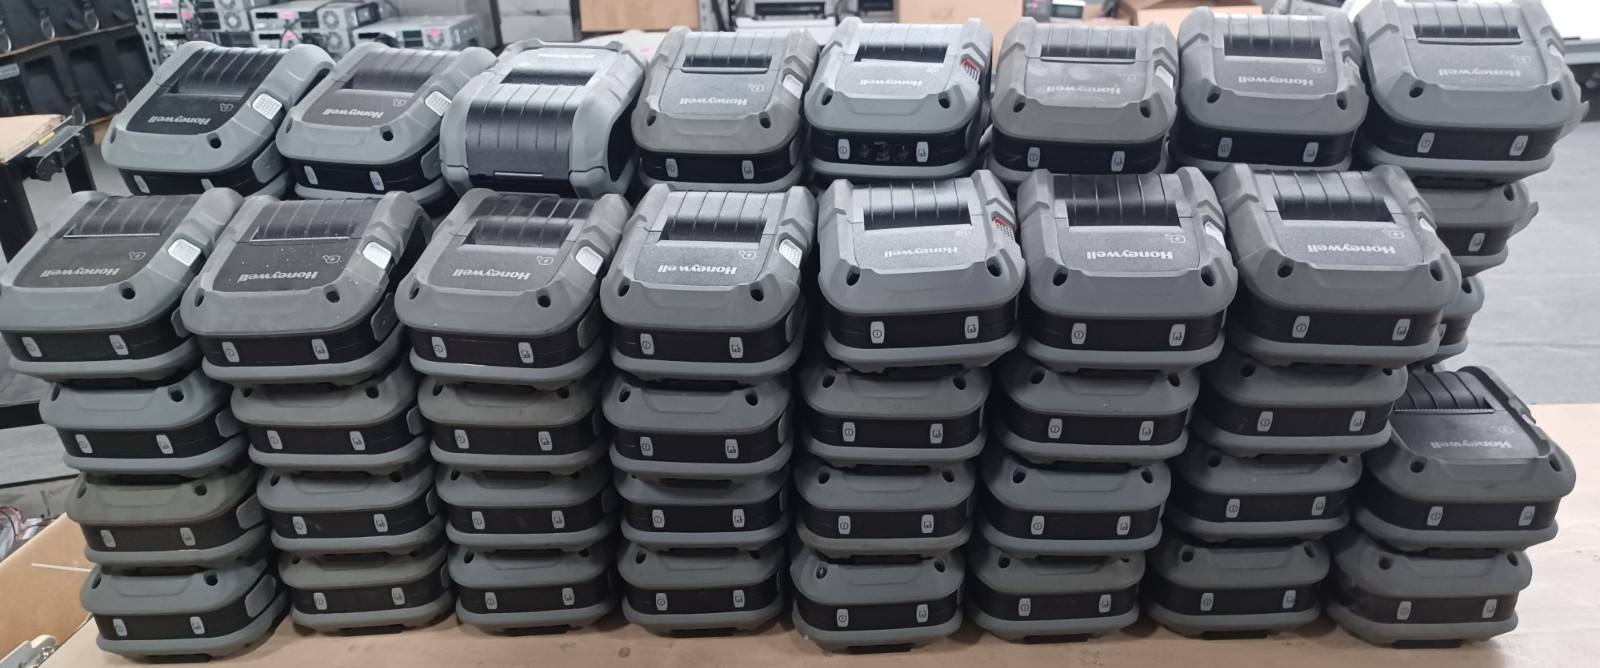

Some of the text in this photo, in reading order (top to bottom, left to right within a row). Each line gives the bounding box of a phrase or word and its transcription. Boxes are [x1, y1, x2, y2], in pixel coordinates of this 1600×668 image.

[1438, 68, 1522, 77] Honeywell
[859, 79, 923, 87] Honeywell
[1238, 76, 1315, 86] Honeywell
[1046, 85, 1121, 95] Honeywell
[680, 97, 748, 106] Honeywell
[322, 108, 384, 119] Honeywell
[147, 115, 211, 125] Honeywell
[884, 246, 958, 258] Honeywell
[1307, 243, 1396, 254] Honeywell
[1086, 250, 1173, 260] Honeywell
[40, 267, 120, 278] Honeywell
[452, 268, 531, 280] Honeywell
[657, 264, 737, 275] Honeywell
[237, 271, 318, 283] Honeywell
